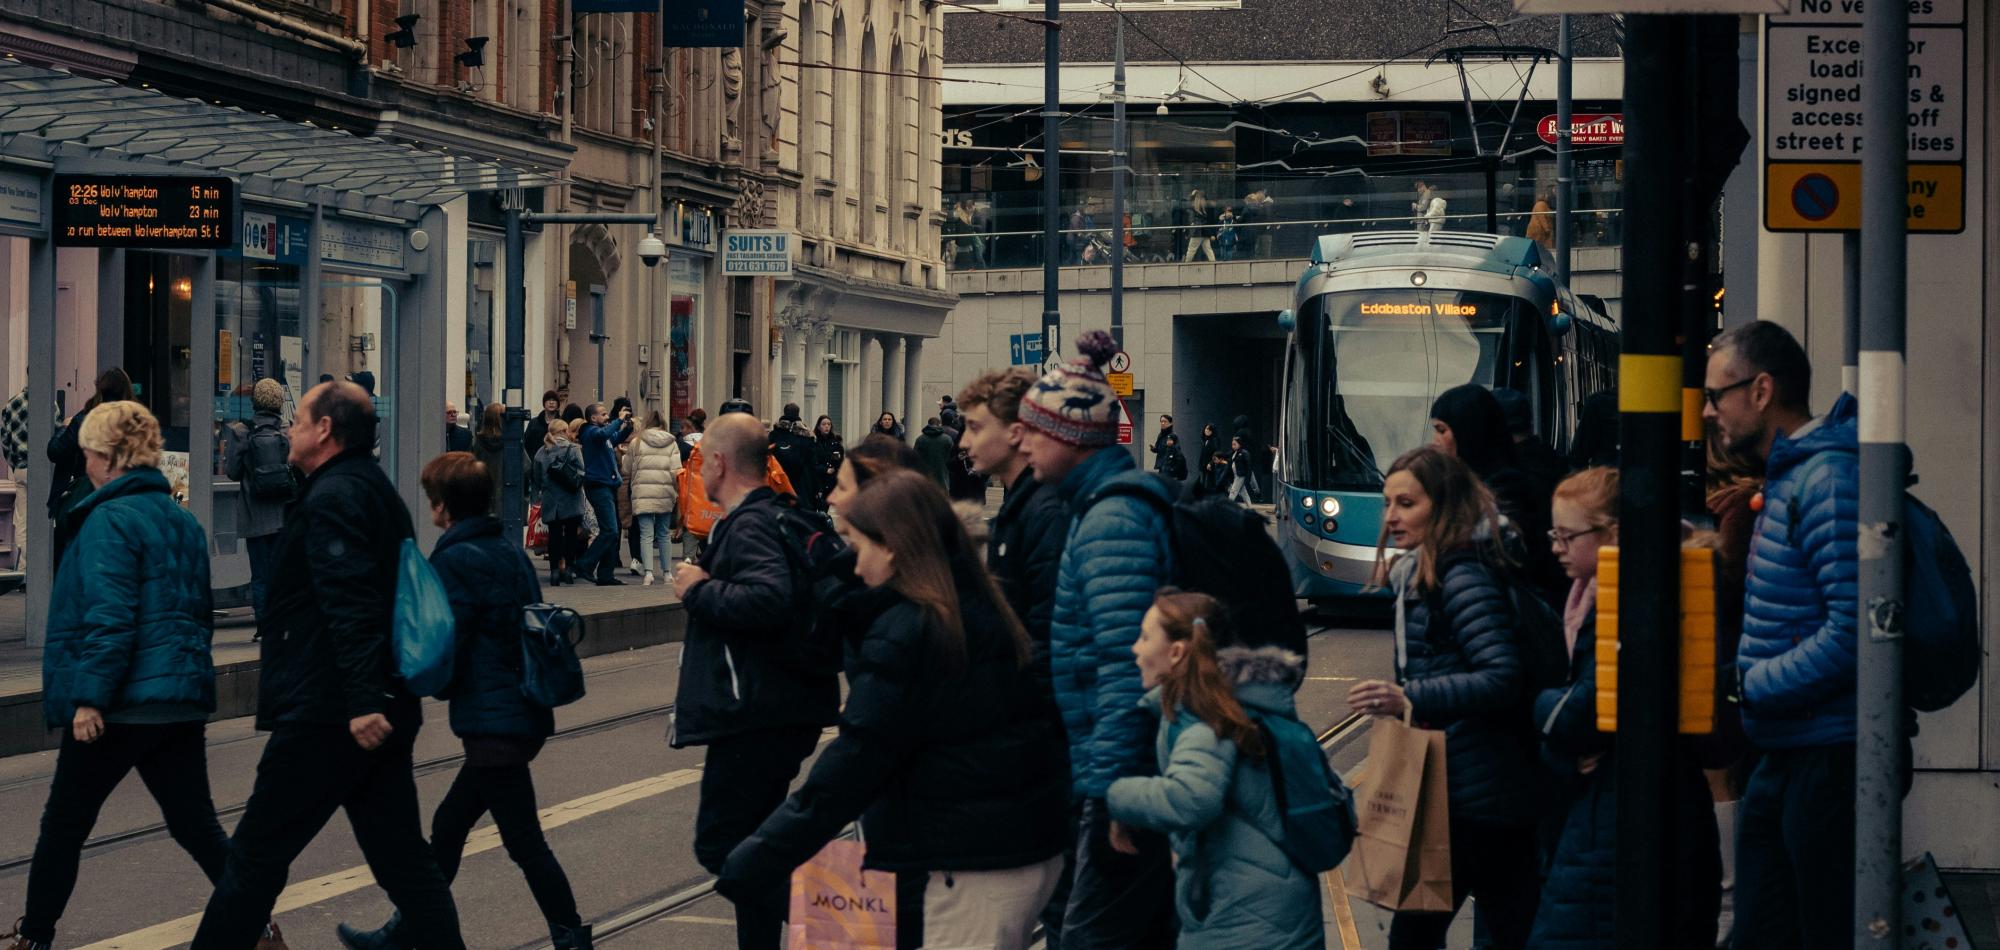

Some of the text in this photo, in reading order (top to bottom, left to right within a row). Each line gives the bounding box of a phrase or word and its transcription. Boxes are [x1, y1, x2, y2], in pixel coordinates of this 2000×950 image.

[1801, 0, 1832, 13] No
[1807, 35, 1860, 53] Exce
[1787, 84, 1860, 104] signed
[1930, 85, 1944, 102] &
[1792, 108, 1939, 126] access off
[1548, 120, 1607, 134] BUETTE
[1776, 132, 1844, 150] street
[70, 184, 219, 200] 12:26 Wolv'hampton 15 min
[100, 204, 219, 219] Wolv'hampton 23 min
[78, 227, 94, 237] run
[97, 224, 131, 237] between
[135, 224, 198, 239] Wolverhampton
[201, 224, 211, 238] St
[729, 235, 785, 251] SUITS U
[729, 261, 785, 271] 0121 631 1679
